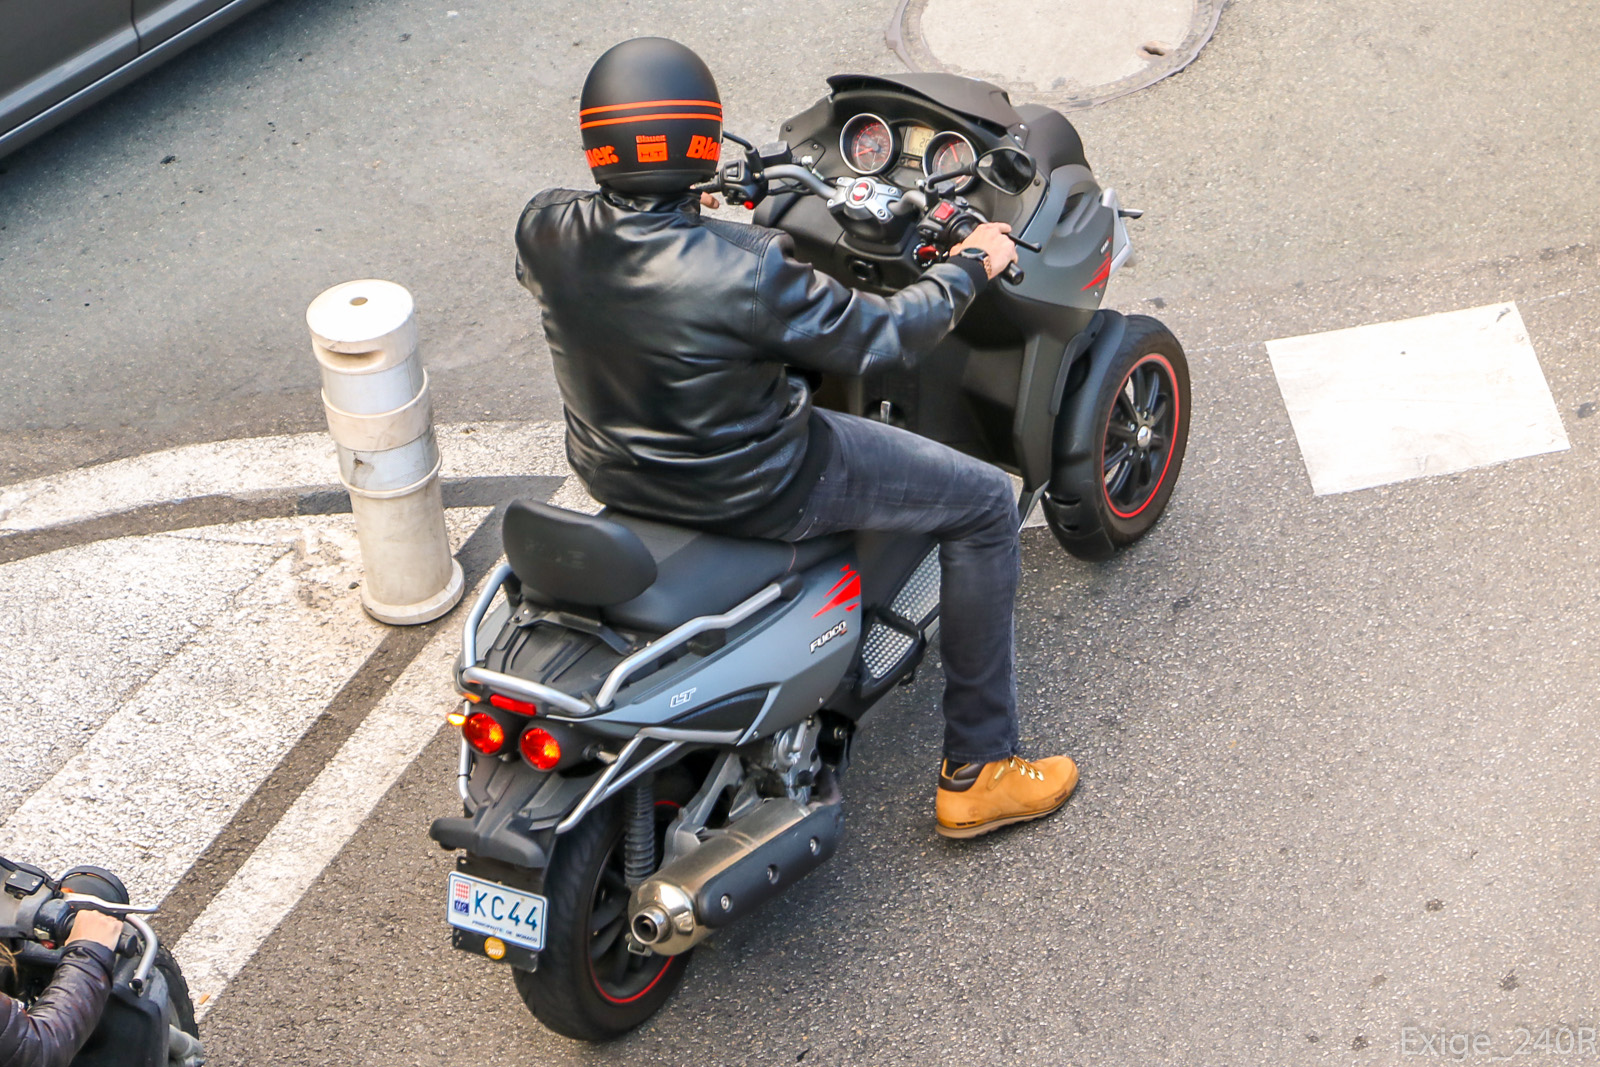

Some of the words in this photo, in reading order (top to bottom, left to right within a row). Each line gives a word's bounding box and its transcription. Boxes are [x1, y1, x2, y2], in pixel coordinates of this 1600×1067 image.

[810, 620, 847, 654] FUOCO
[669, 687, 697, 708] LT
[474, 890, 538, 931] KC44
